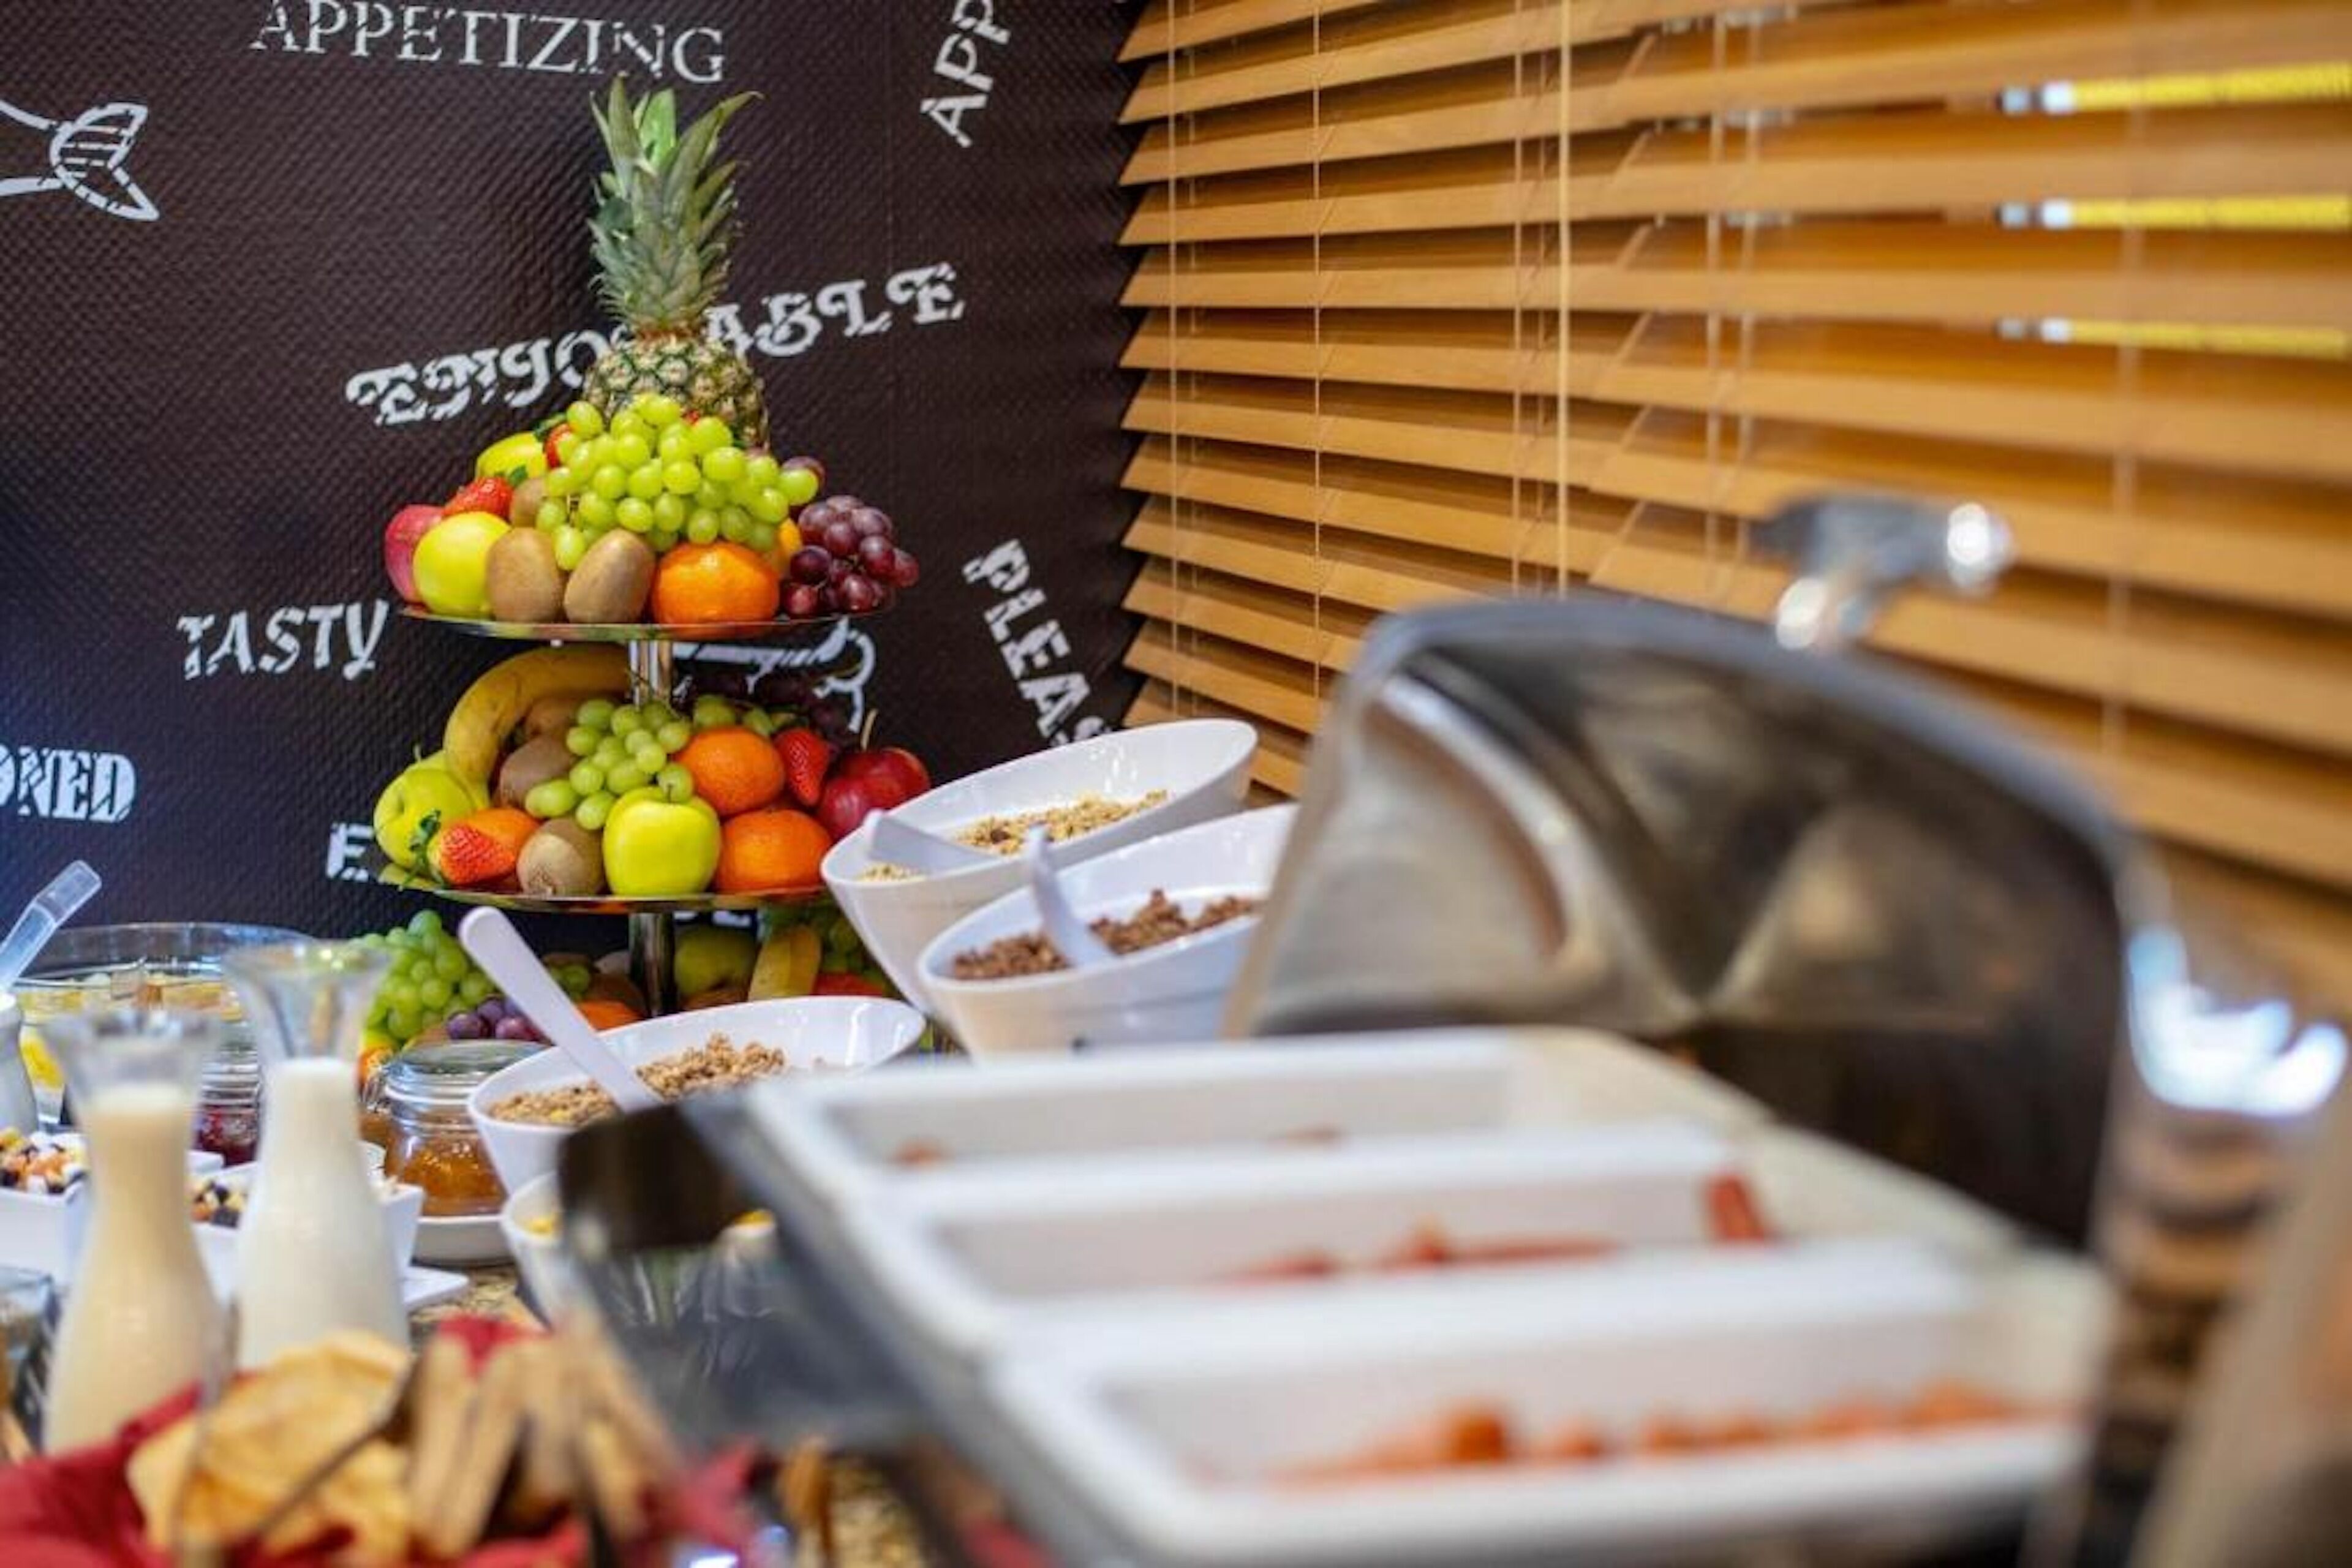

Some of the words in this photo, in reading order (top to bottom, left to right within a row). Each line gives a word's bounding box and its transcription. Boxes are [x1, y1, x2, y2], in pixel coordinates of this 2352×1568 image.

[249, 0, 725, 83] APPETIZING
[346, 262, 966, 426] ENJOABLE
[176, 599, 390, 680] TASTY
